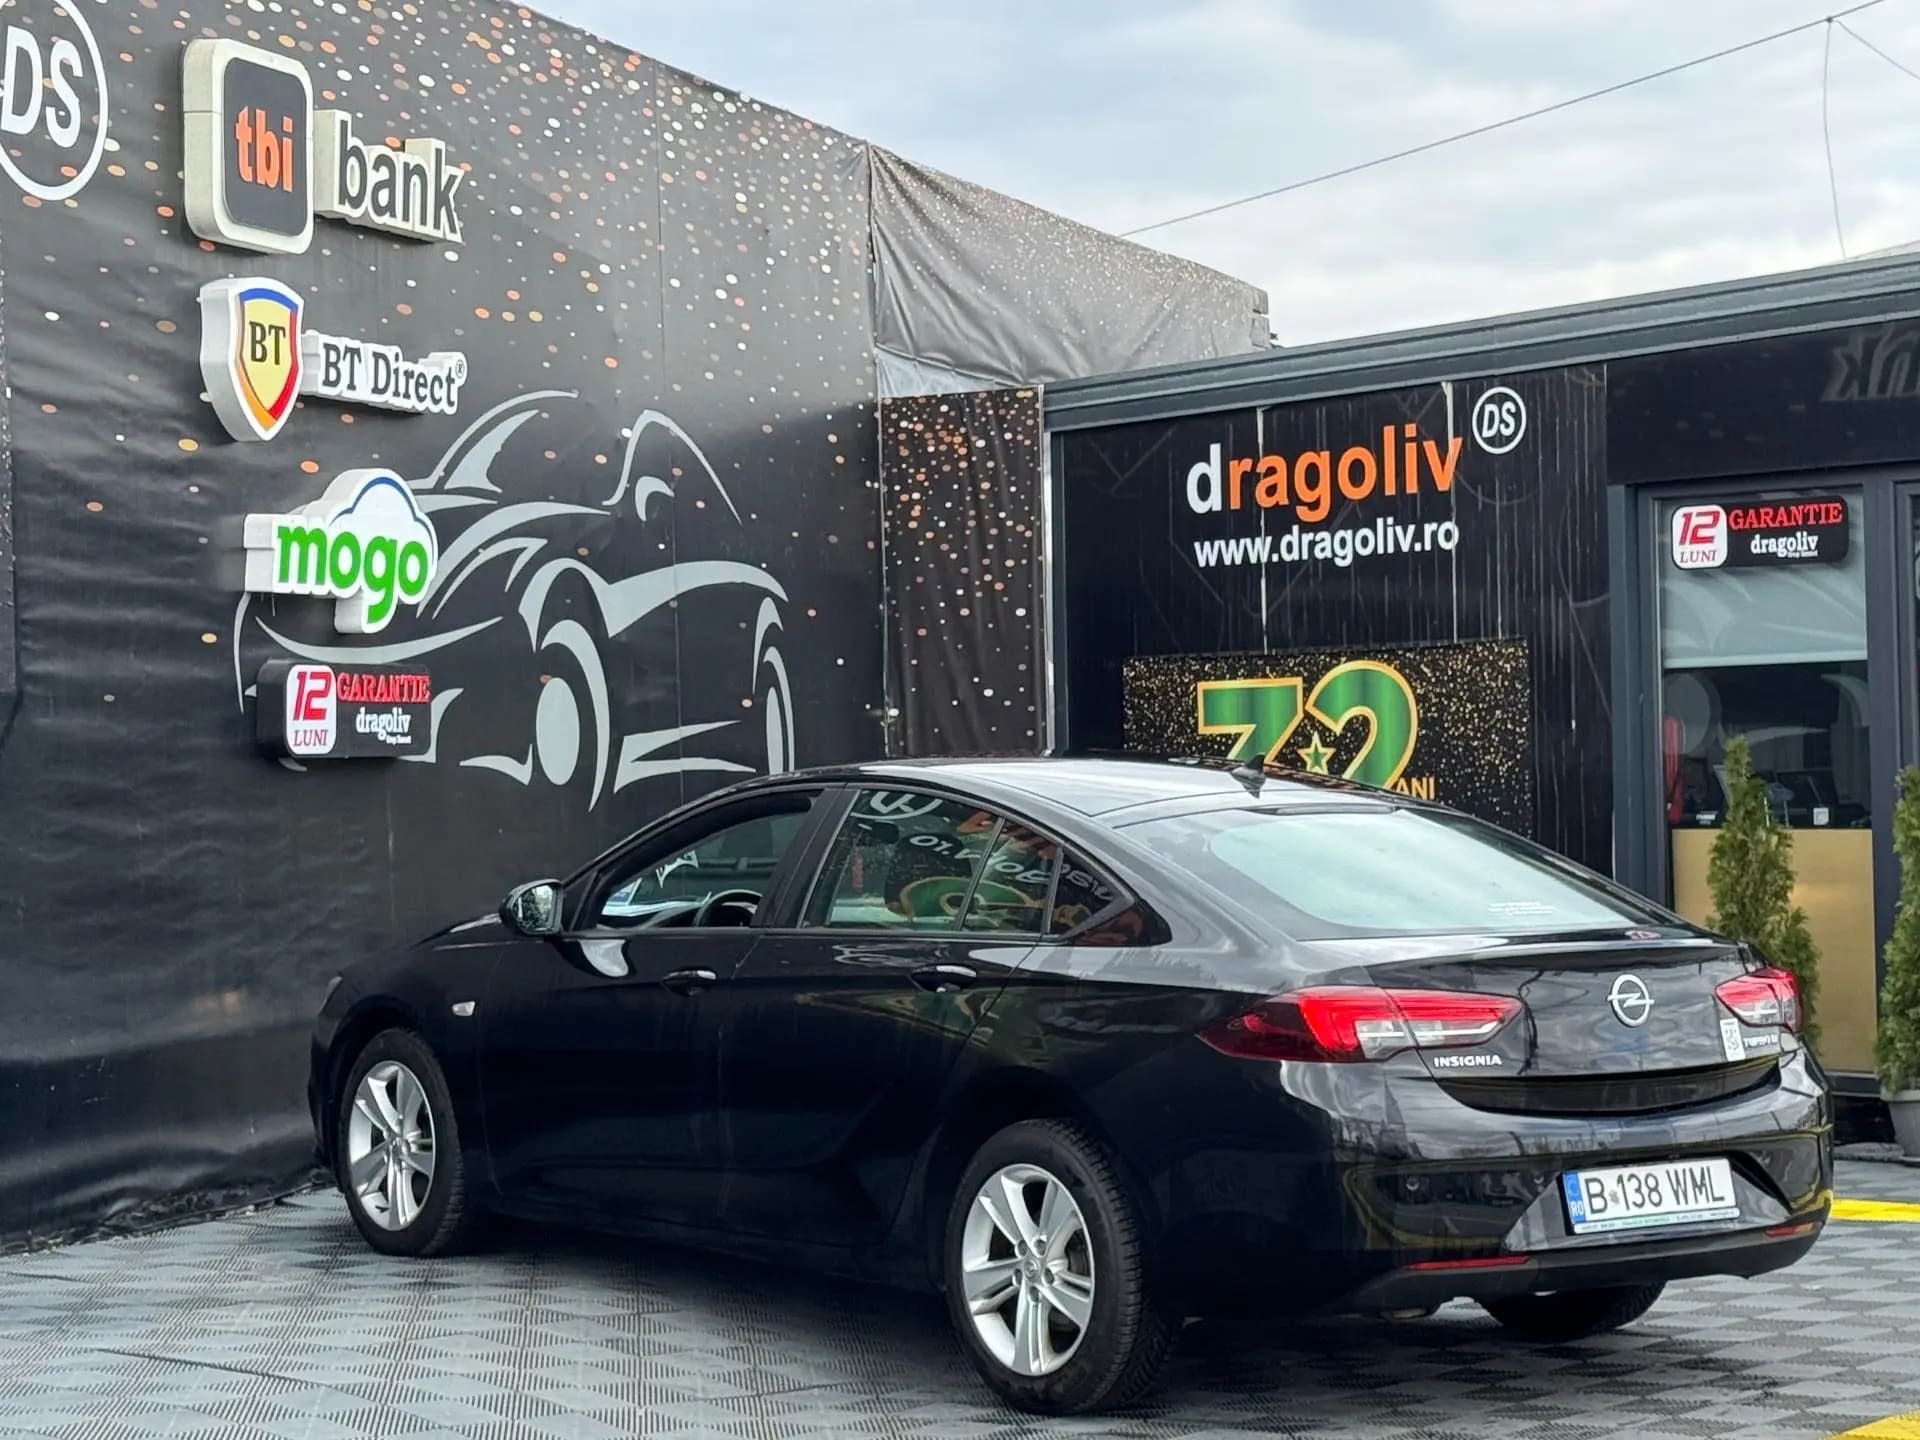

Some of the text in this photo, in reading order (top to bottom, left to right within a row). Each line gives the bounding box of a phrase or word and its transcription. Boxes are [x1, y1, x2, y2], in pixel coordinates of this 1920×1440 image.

[1, 25, 83, 148] DS
[236, 106, 457, 234] tbi bank
[249, 321, 286, 365] BT
[322, 343, 362, 391] BT
[1481, 400, 1516, 439] DS
[1186, 423, 1463, 522] dragoliv
[1193, 516, 1460, 568] www.dragoliv.ro
[1678, 503, 1843, 545] 12 GARANTIE
[1750, 531, 1819, 557] dragoliv
[278, 525, 429, 623] mogo
[1679, 550, 1718, 563] LUNI
[293, 671, 431, 720] 12 GARANTIE
[293, 729, 328, 747] LUNI
[355, 706, 411, 740] dragoliv
[1396, 776, 1435, 800] ANI
[1434, 1054, 1502, 1068] INSIGNIA
[1570, 1201, 1584, 1217] RO
[1584, 1166, 1725, 1215] B 138 WML
